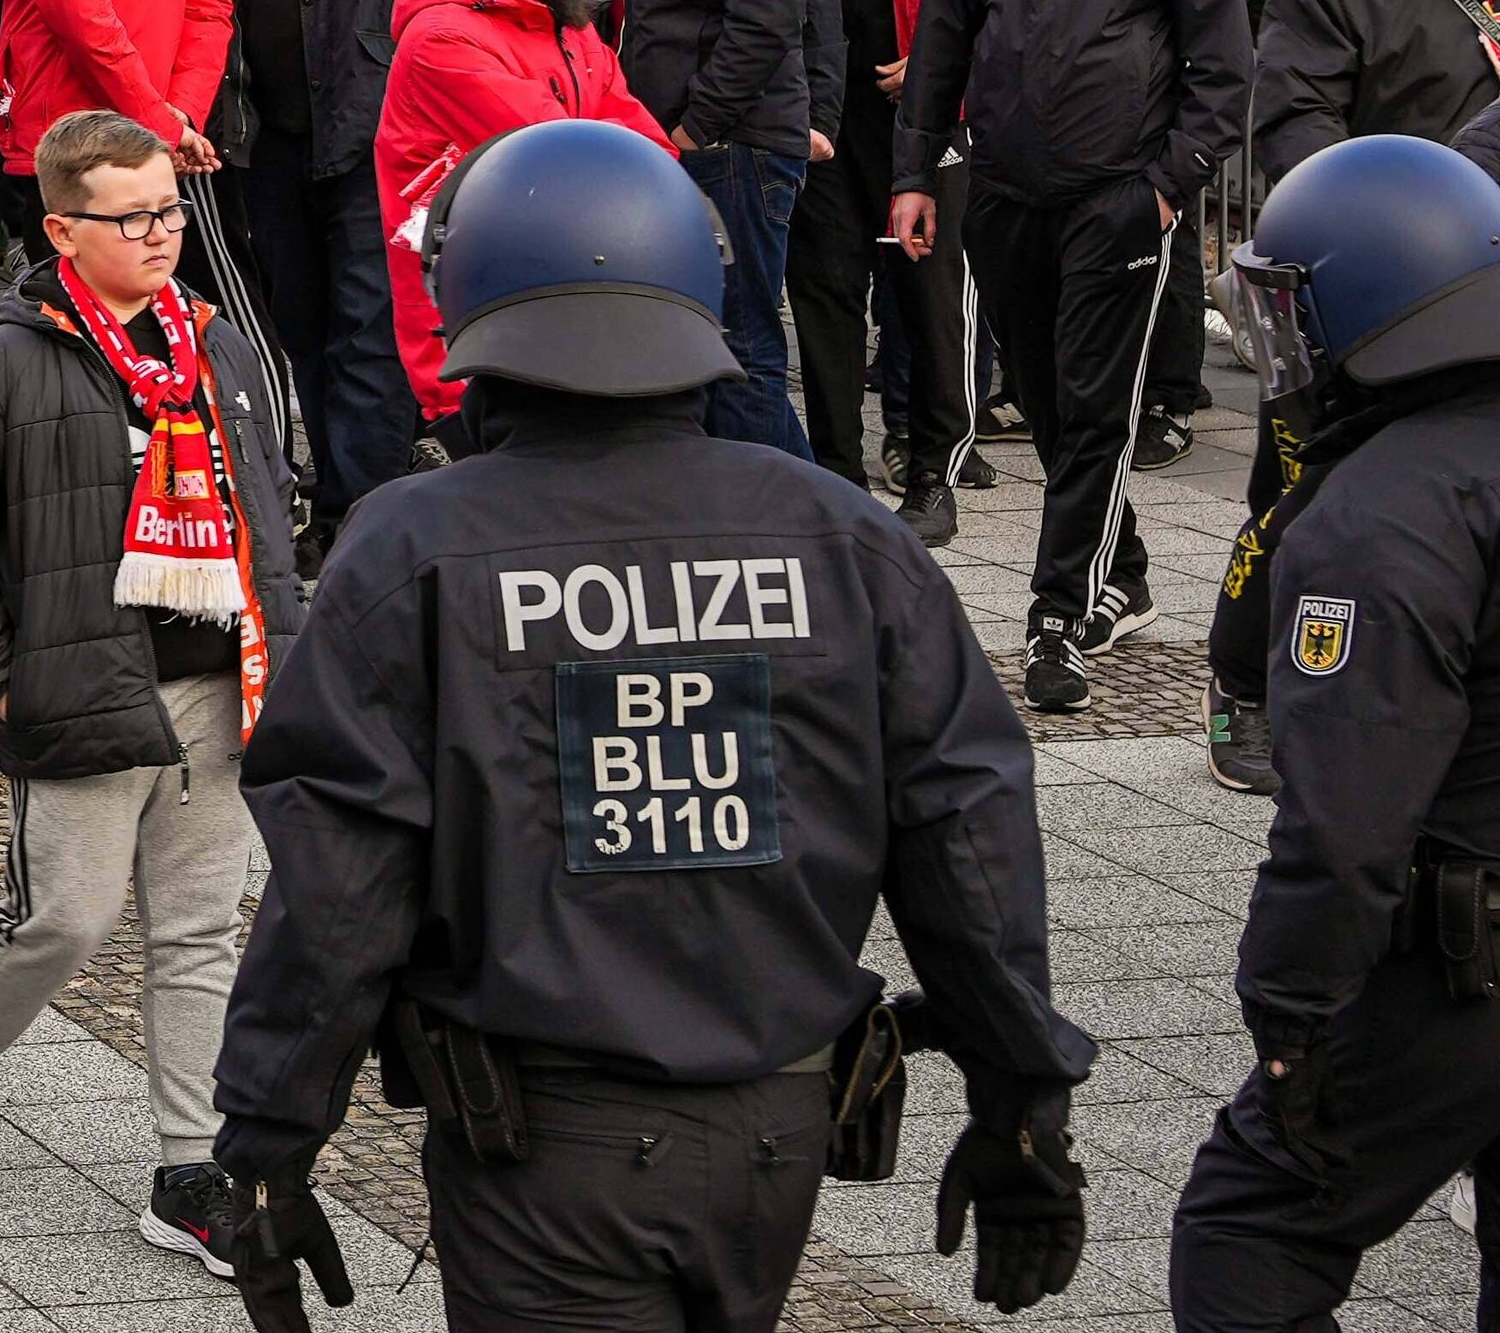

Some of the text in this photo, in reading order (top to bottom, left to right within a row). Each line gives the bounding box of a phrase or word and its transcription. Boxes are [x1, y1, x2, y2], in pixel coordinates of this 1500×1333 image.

[1128, 255, 1157, 270] adidas
[135, 504, 218, 548] Berlin
[498, 557, 811, 652] POLIZEI
[1301, 600, 1349, 620] POLIZEI
[616, 672, 714, 728] BP
[592, 731, 739, 792] BLU
[592, 794, 750, 855] 3110
